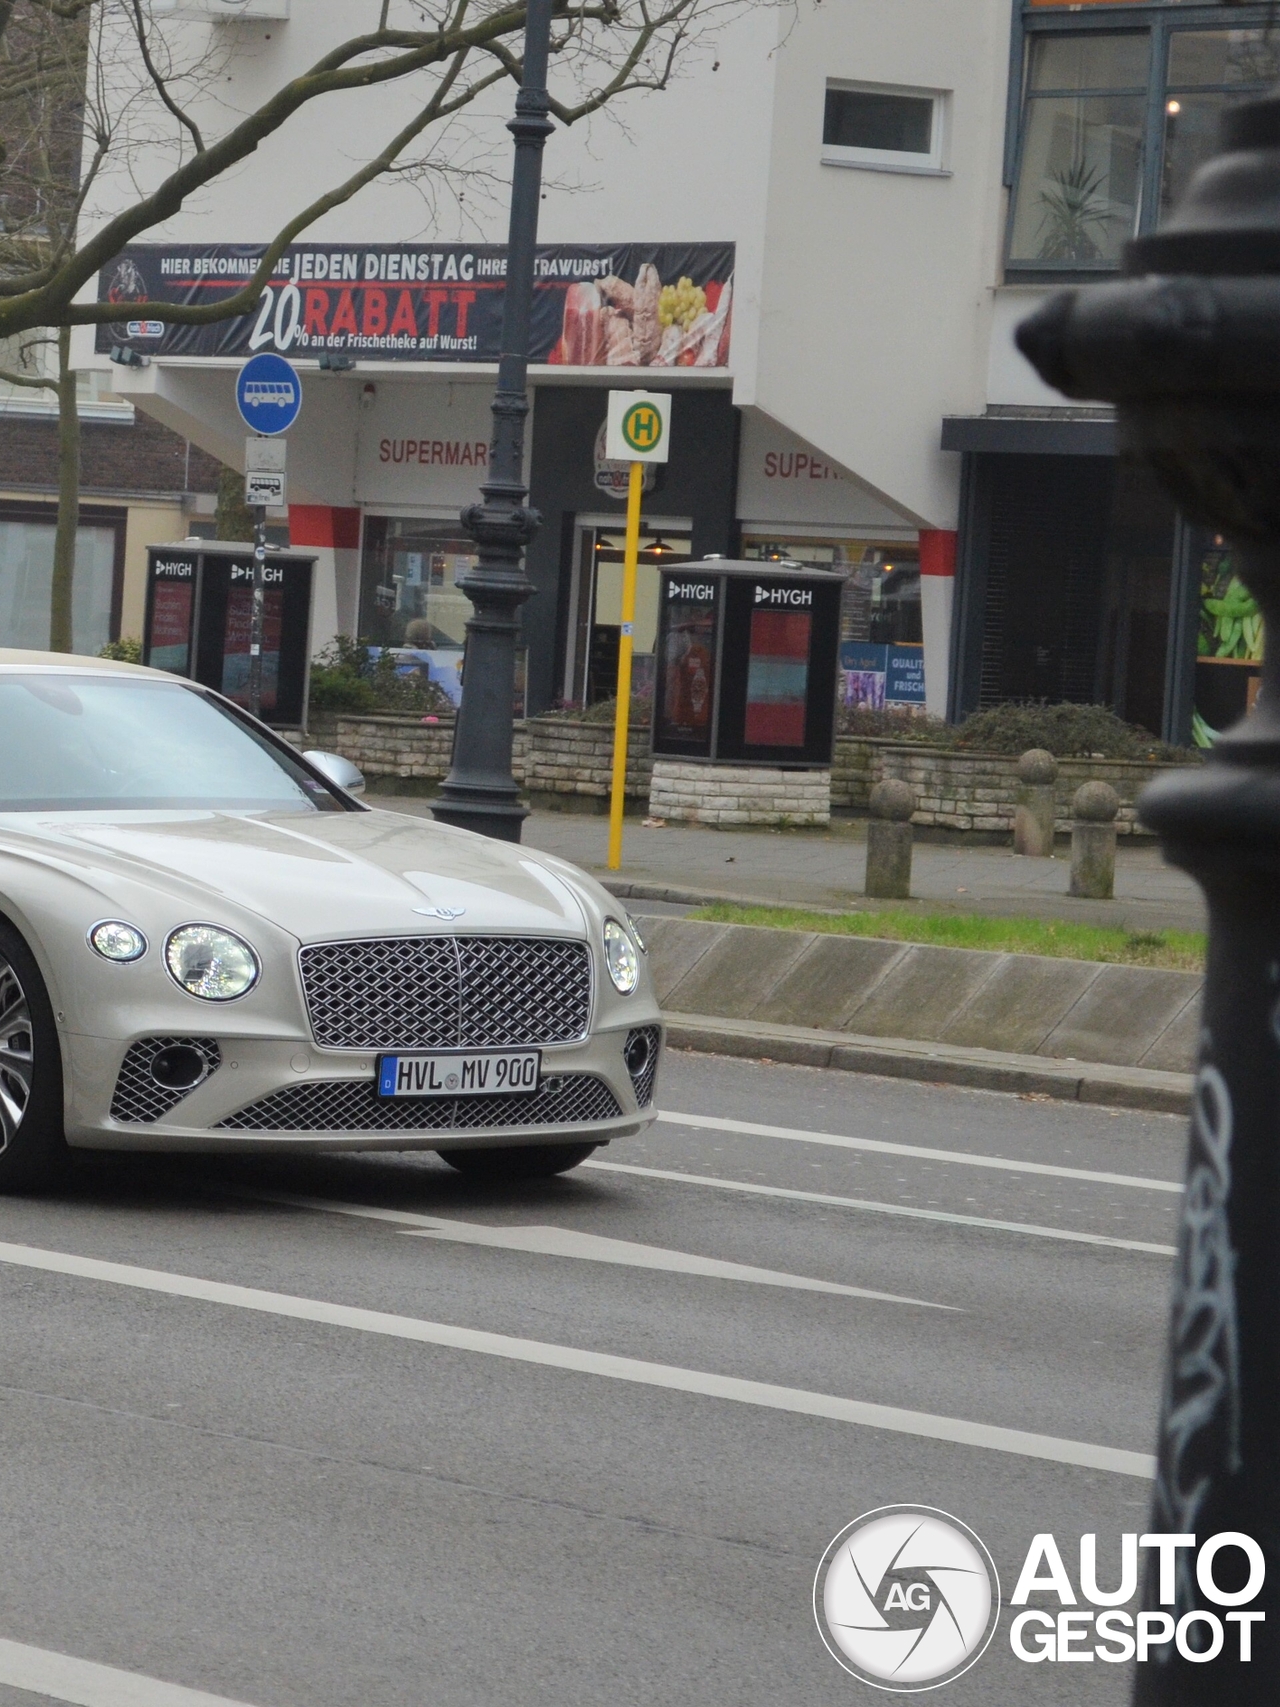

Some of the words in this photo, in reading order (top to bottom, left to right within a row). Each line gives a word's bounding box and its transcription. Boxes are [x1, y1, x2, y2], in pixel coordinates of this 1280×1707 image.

[161, 258, 190, 274] HIER
[272, 258, 290, 274] IE
[289, 253, 357, 285] JEDEN
[365, 254, 473, 281] DIENSTAG
[477, 259, 507, 275] IHRE
[533, 258, 613, 276] TRAWURST!
[305, 288, 477, 337] RABATT
[311, 335, 324, 347] an
[327, 333, 345, 347] der
[347, 333, 417, 348] Frischetheke
[420, 335, 438, 348] auf
[440, 335, 478, 350] Wurst!
[633, 412, 654, 441] H
[380, 439, 487, 466] SUPERMAR
[165, 562, 192, 577] HYGH
[681, 583, 714, 600] HYGH
[771, 588, 812, 605] HYGH
[892, 658, 924, 670] QUALIT
[906, 670, 922, 680] und
[894, 680, 924, 692] FRISCH
[397, 1060, 442, 1090] HVL
[461, 1059, 490, 1089] MV
[495, 1057, 535, 1088] 900
[384, 1079, 391, 1089] D
